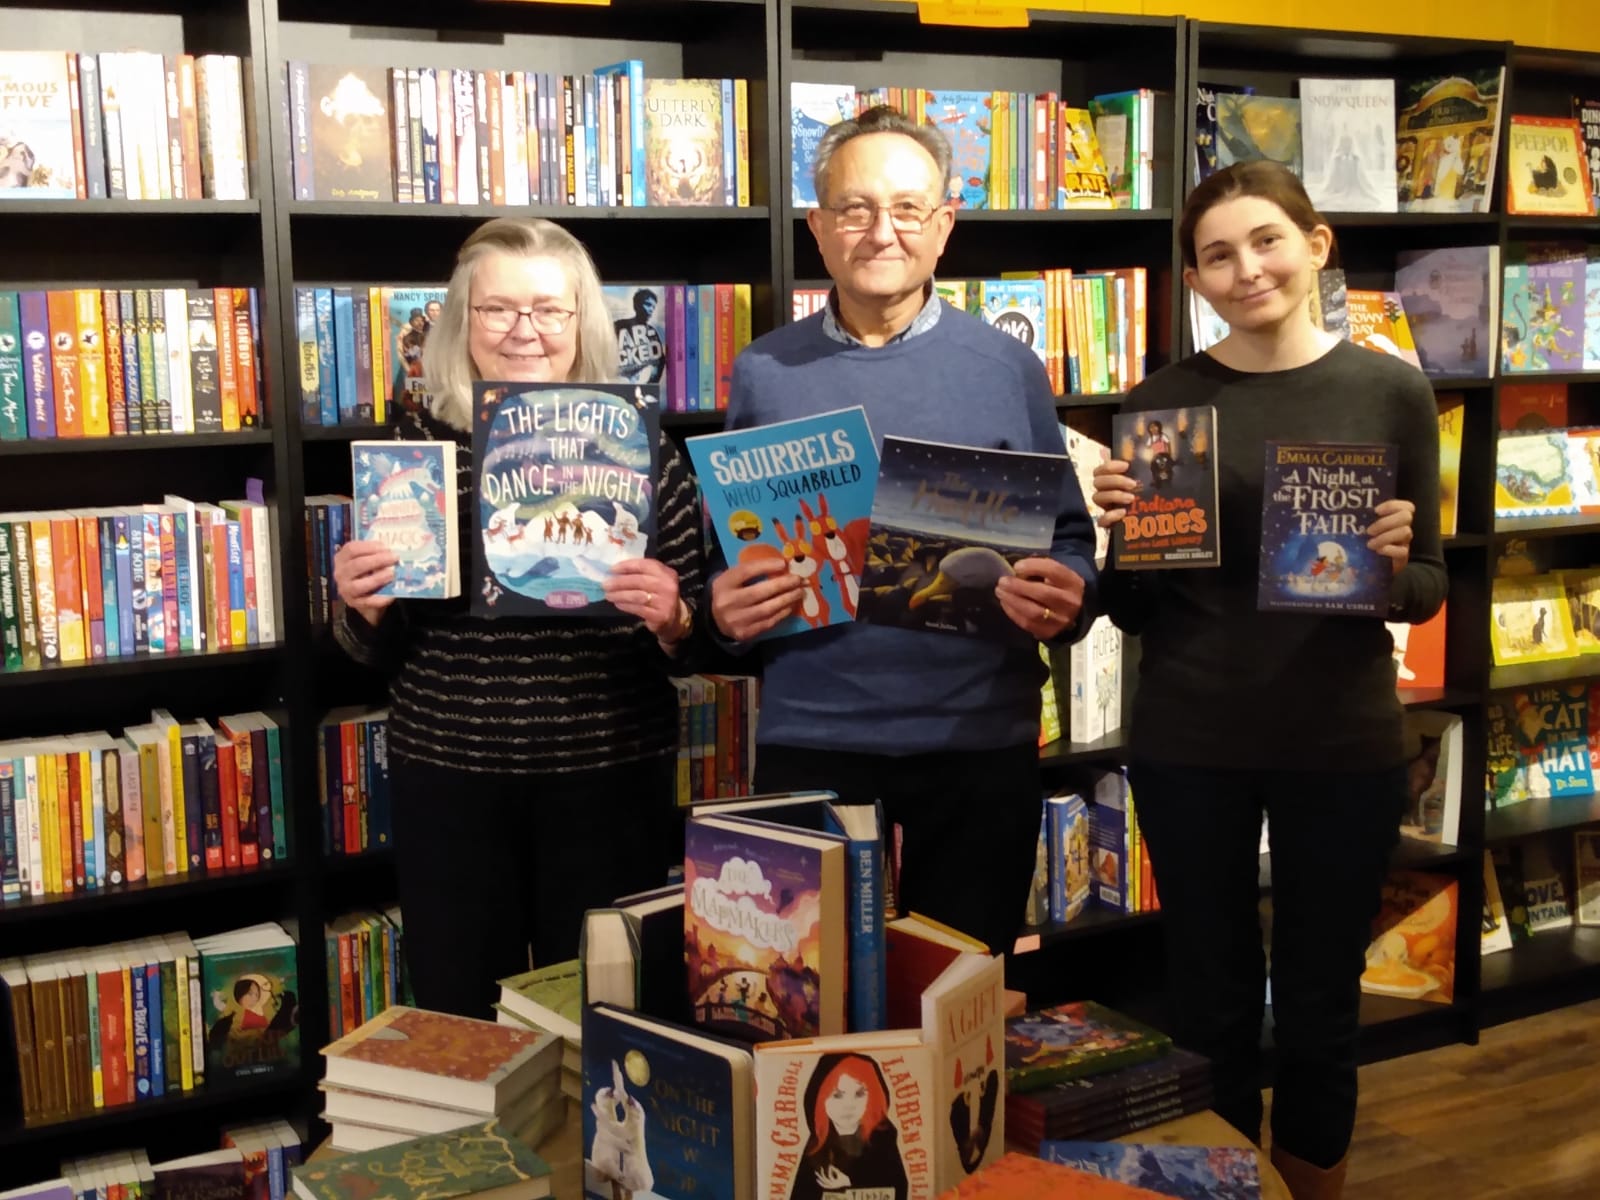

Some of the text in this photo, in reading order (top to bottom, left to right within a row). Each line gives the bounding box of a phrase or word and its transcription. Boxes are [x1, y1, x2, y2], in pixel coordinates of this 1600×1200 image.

[3, 95, 52, 109] FIVE
[647, 97, 716, 115] UTTERLY
[1307, 95, 1389, 109] SNOW QUEEN
[659, 112, 708, 128] DARK
[797, 125, 827, 138] Snowfl
[566, 134, 575, 155] TOM
[1513, 132, 1569, 153] PEEPO!
[566, 157, 576, 194] PALMER
[1066, 172, 1111, 192] RATE
[394, 291, 421, 300] NANCY
[1349, 303, 1368, 312] THE
[1346, 312, 1384, 324] NOWY
[1349, 323, 1375, 335] DAY
[236, 315, 251, 367] LIONBOY
[618, 324, 656, 350] AR-
[618, 340, 662, 367] CKED
[501, 392, 630, 439] THE LIGHTS
[547, 437, 588, 460] THAT
[709, 428, 856, 485] SQUIRRELS
[1276, 449, 1386, 466] EMMA CARROLL
[486, 465, 574, 505] DANCE IN
[558, 466, 649, 504] THE NIGHT
[723, 464, 861, 508] WHO SQUABBLED
[1282, 468, 1300, 485] A
[1307, 466, 1360, 489] Night
[1127, 494, 1196, 515] Indiana
[1272, 485, 1380, 512] the FROST
[1293, 511, 1367, 536] FAIR
[1325, 602, 1344, 610] SAM
[1346, 602, 1376, 612] USHER
[1533, 688, 1561, 702] THE
[1540, 701, 1586, 730] CAT
[1541, 744, 1588, 774] HAT
[858, 849, 873, 878] BEN
[1526, 880, 1564, 907] OVE
[692, 886, 795, 946] MAPMAKERS
[859, 879, 874, 935] MILLER
[1529, 904, 1569, 922] NTAIN
[134, 1007, 149, 1046] BRAVE
[882, 1056, 923, 1145] LAUREN
[770, 1059, 803, 1200] CARROLL MMA
